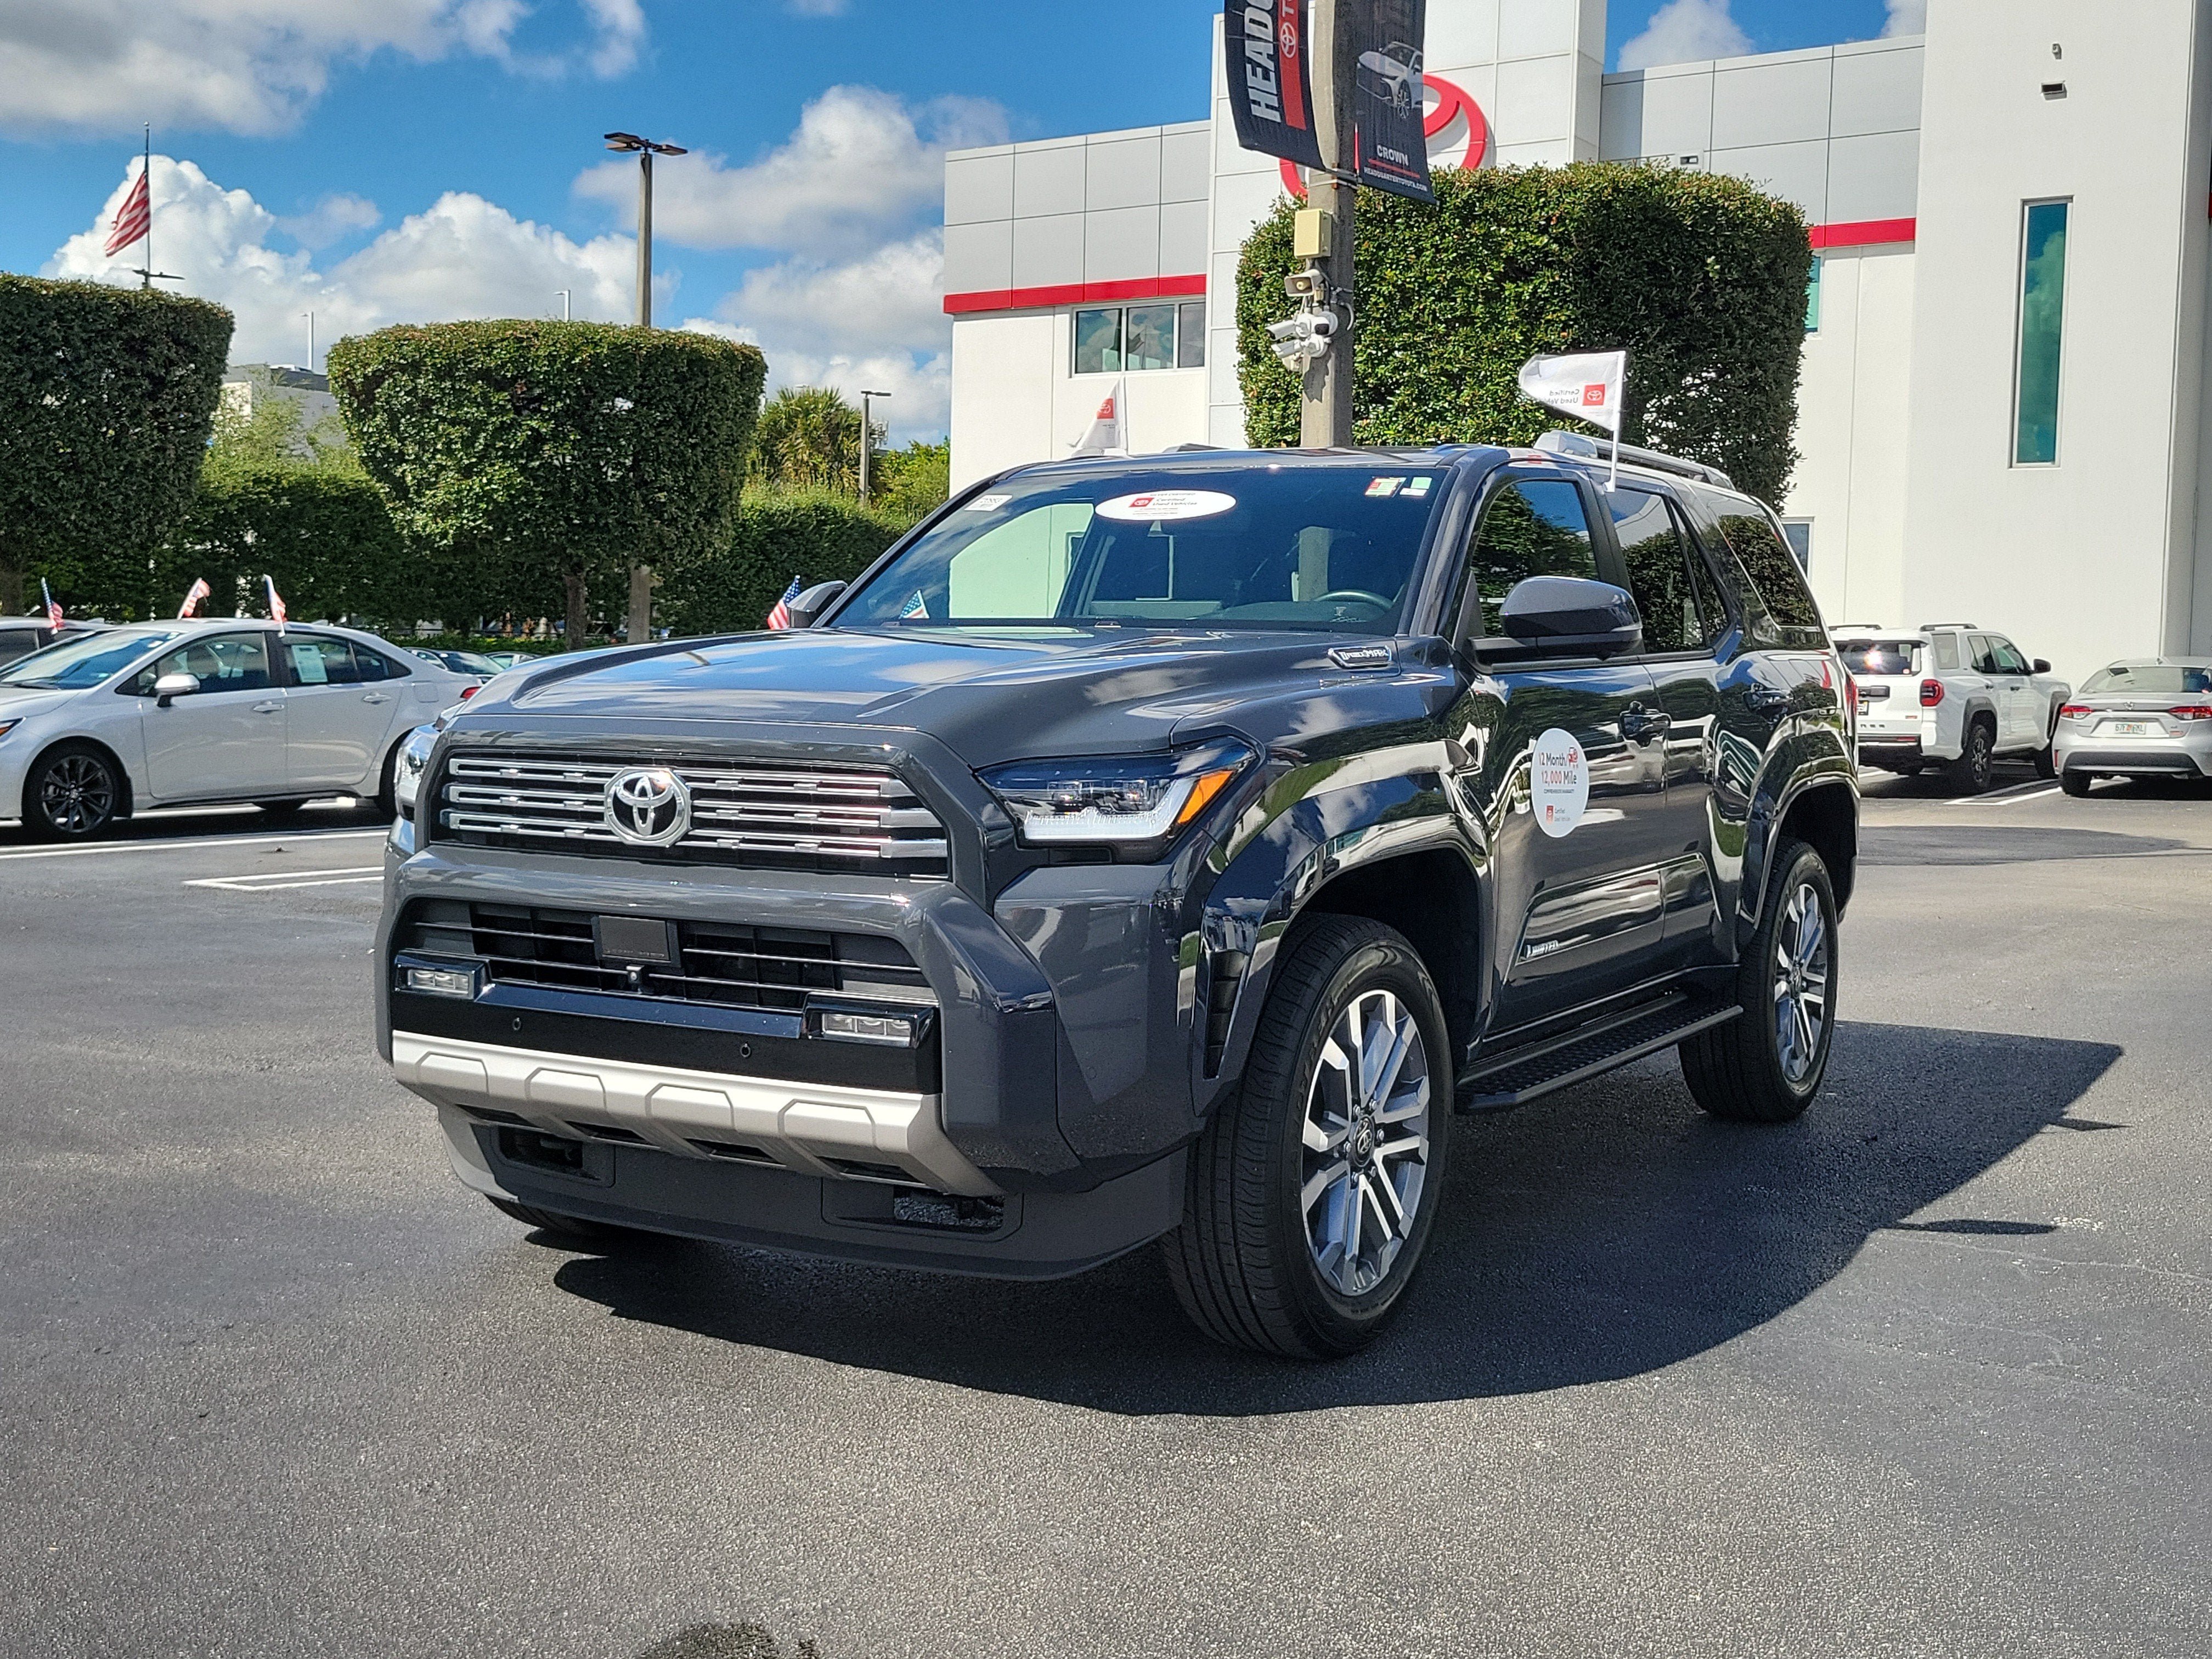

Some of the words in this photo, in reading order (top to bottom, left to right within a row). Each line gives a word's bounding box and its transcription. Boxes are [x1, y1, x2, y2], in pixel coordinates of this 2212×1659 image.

[1244, 0, 1281, 122] HEAD
[1376, 144, 1409, 166] CROWN
[1542, 770, 1562, 786] 12,000
[1563, 770, 1577, 785] Mile
